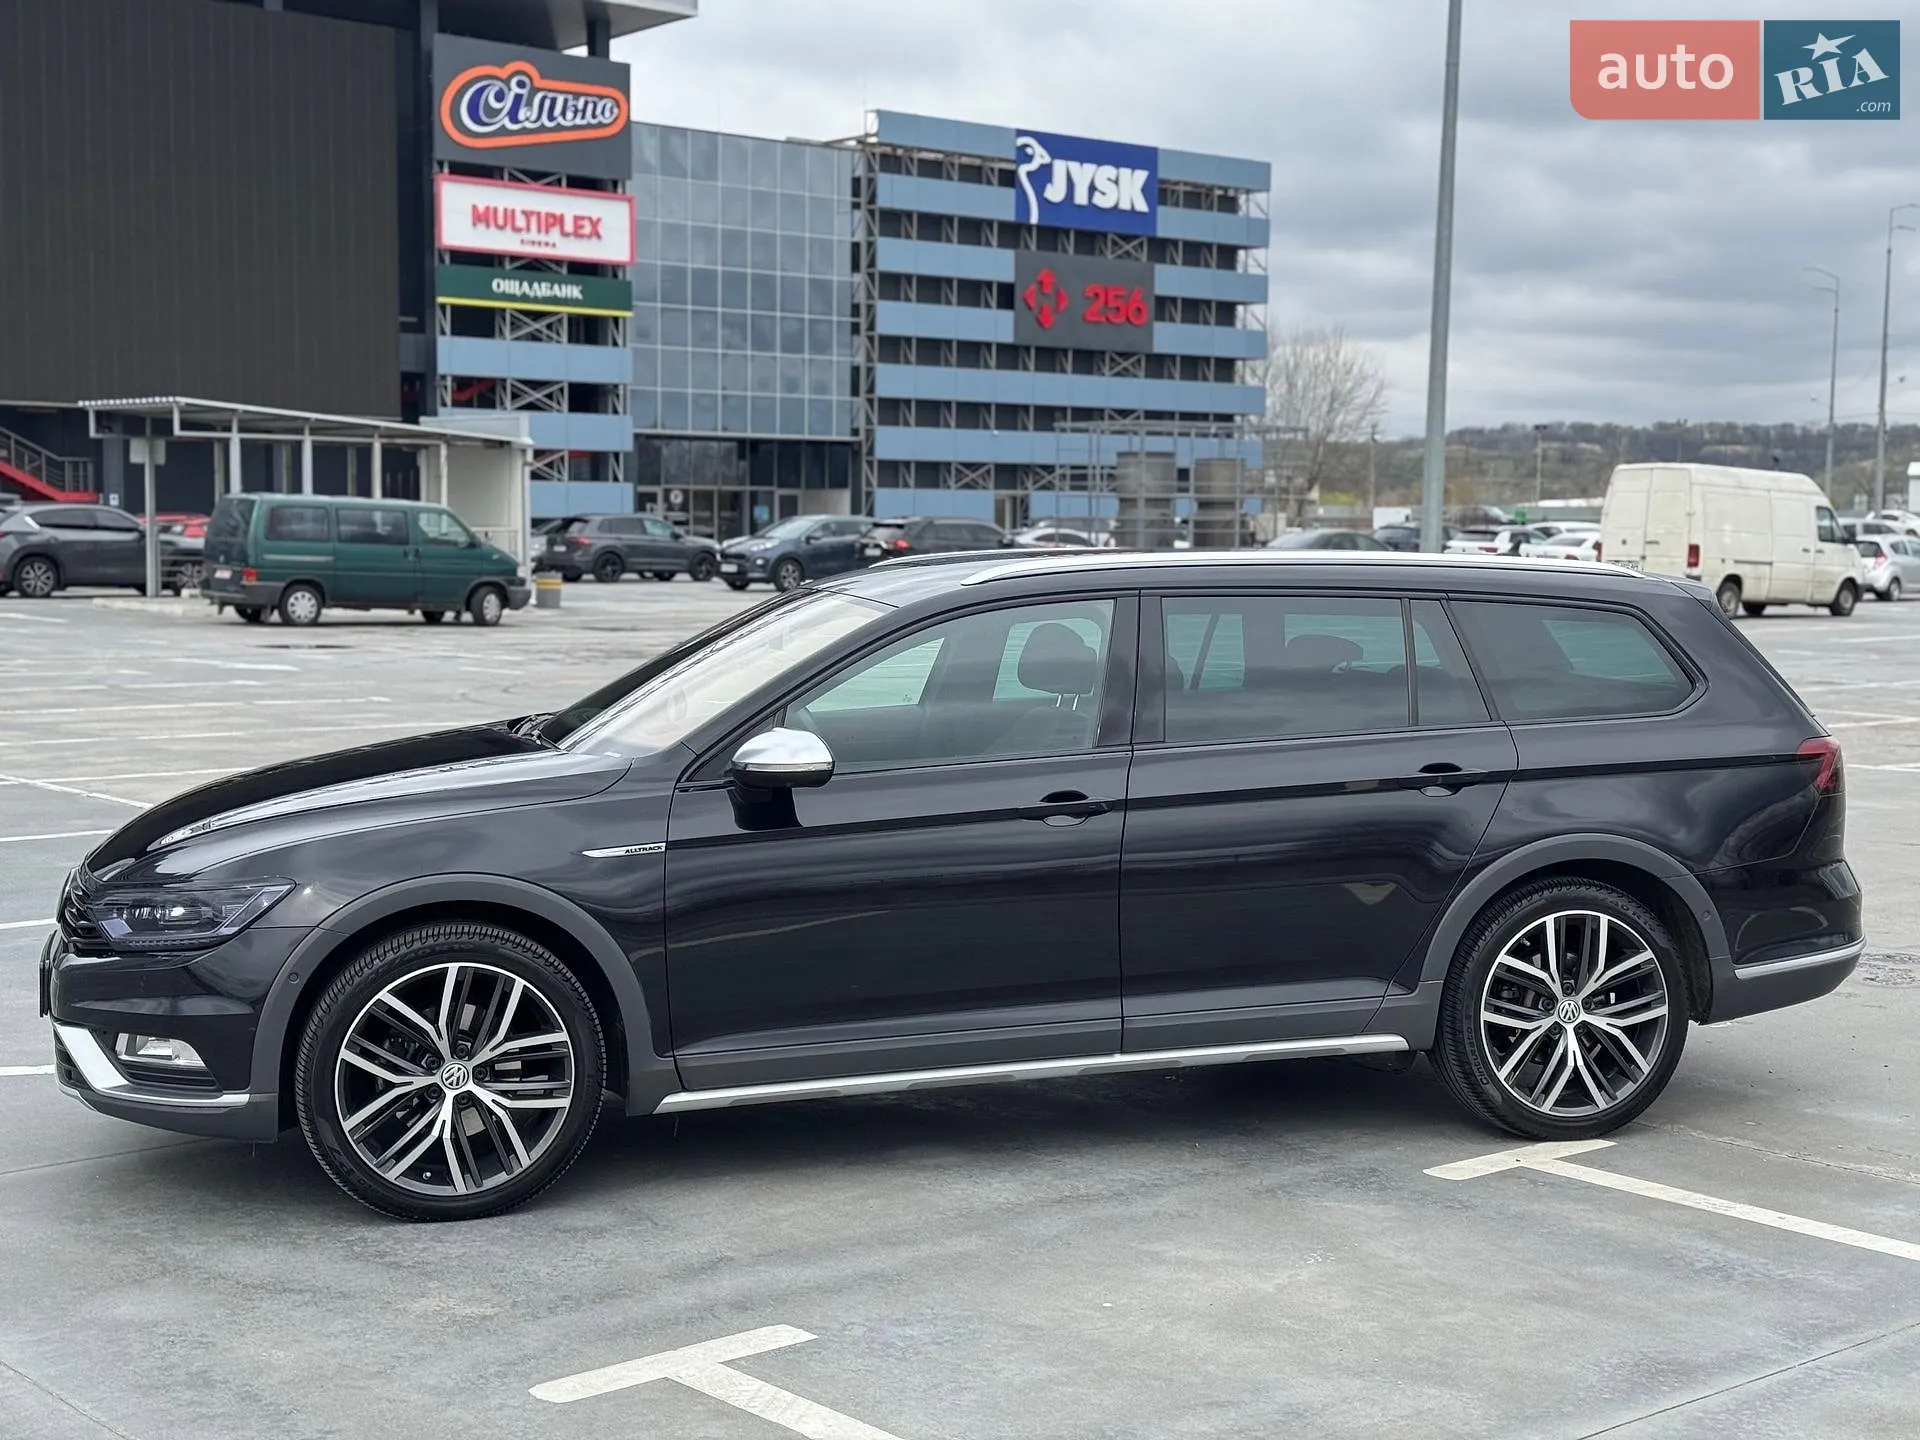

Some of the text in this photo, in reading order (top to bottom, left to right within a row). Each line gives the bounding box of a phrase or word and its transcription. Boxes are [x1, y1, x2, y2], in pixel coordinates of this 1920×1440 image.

[460, 74, 620, 133] Сільпо
[1043, 158, 1150, 214] JYSK
[471, 204, 603, 240] MULTIPLEX
[491, 277, 583, 300] ОЩАДБАНК
[1082, 282, 1149, 327] 256
[624, 845, 663, 855] ALLTRACK
